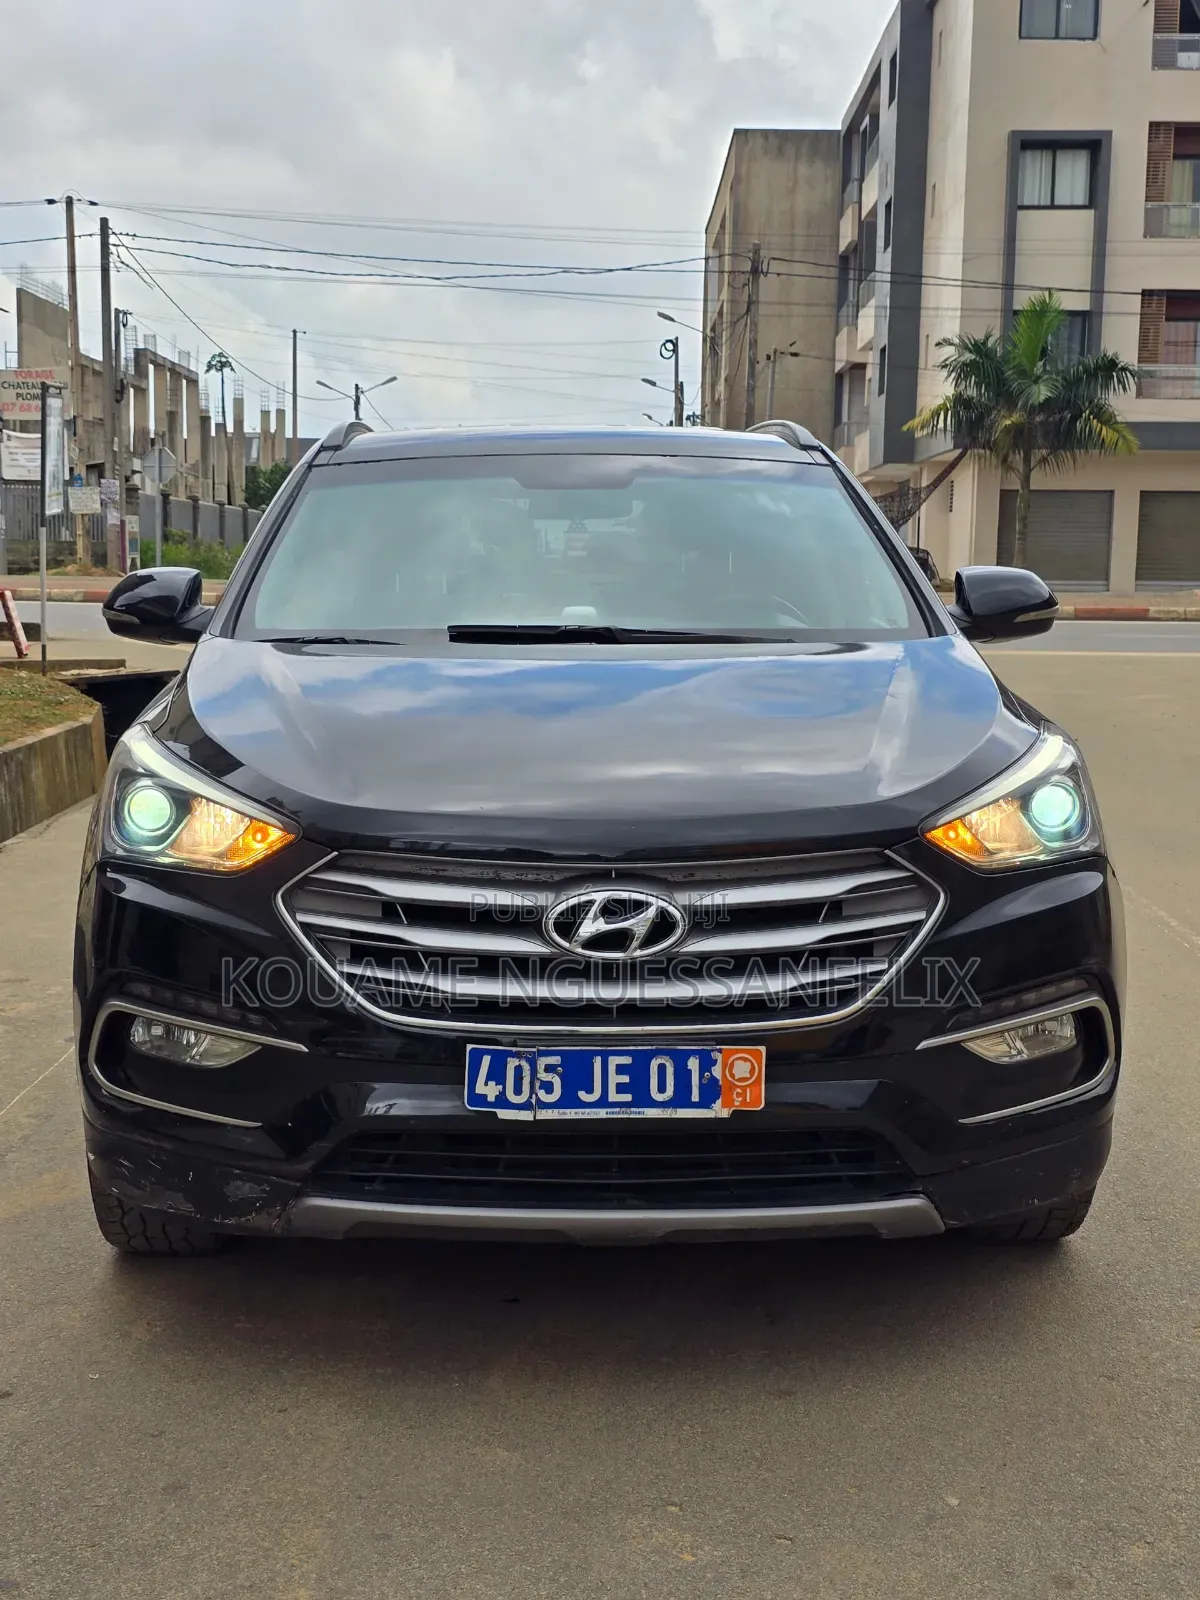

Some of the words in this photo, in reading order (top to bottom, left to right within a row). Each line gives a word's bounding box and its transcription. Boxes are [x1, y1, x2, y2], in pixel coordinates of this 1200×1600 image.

[15, 370, 55, 380] FORAGE
[475, 1054, 562, 1104] 405
[577, 1055, 633, 1103] JE
[650, 1054, 700, 1103] 01
